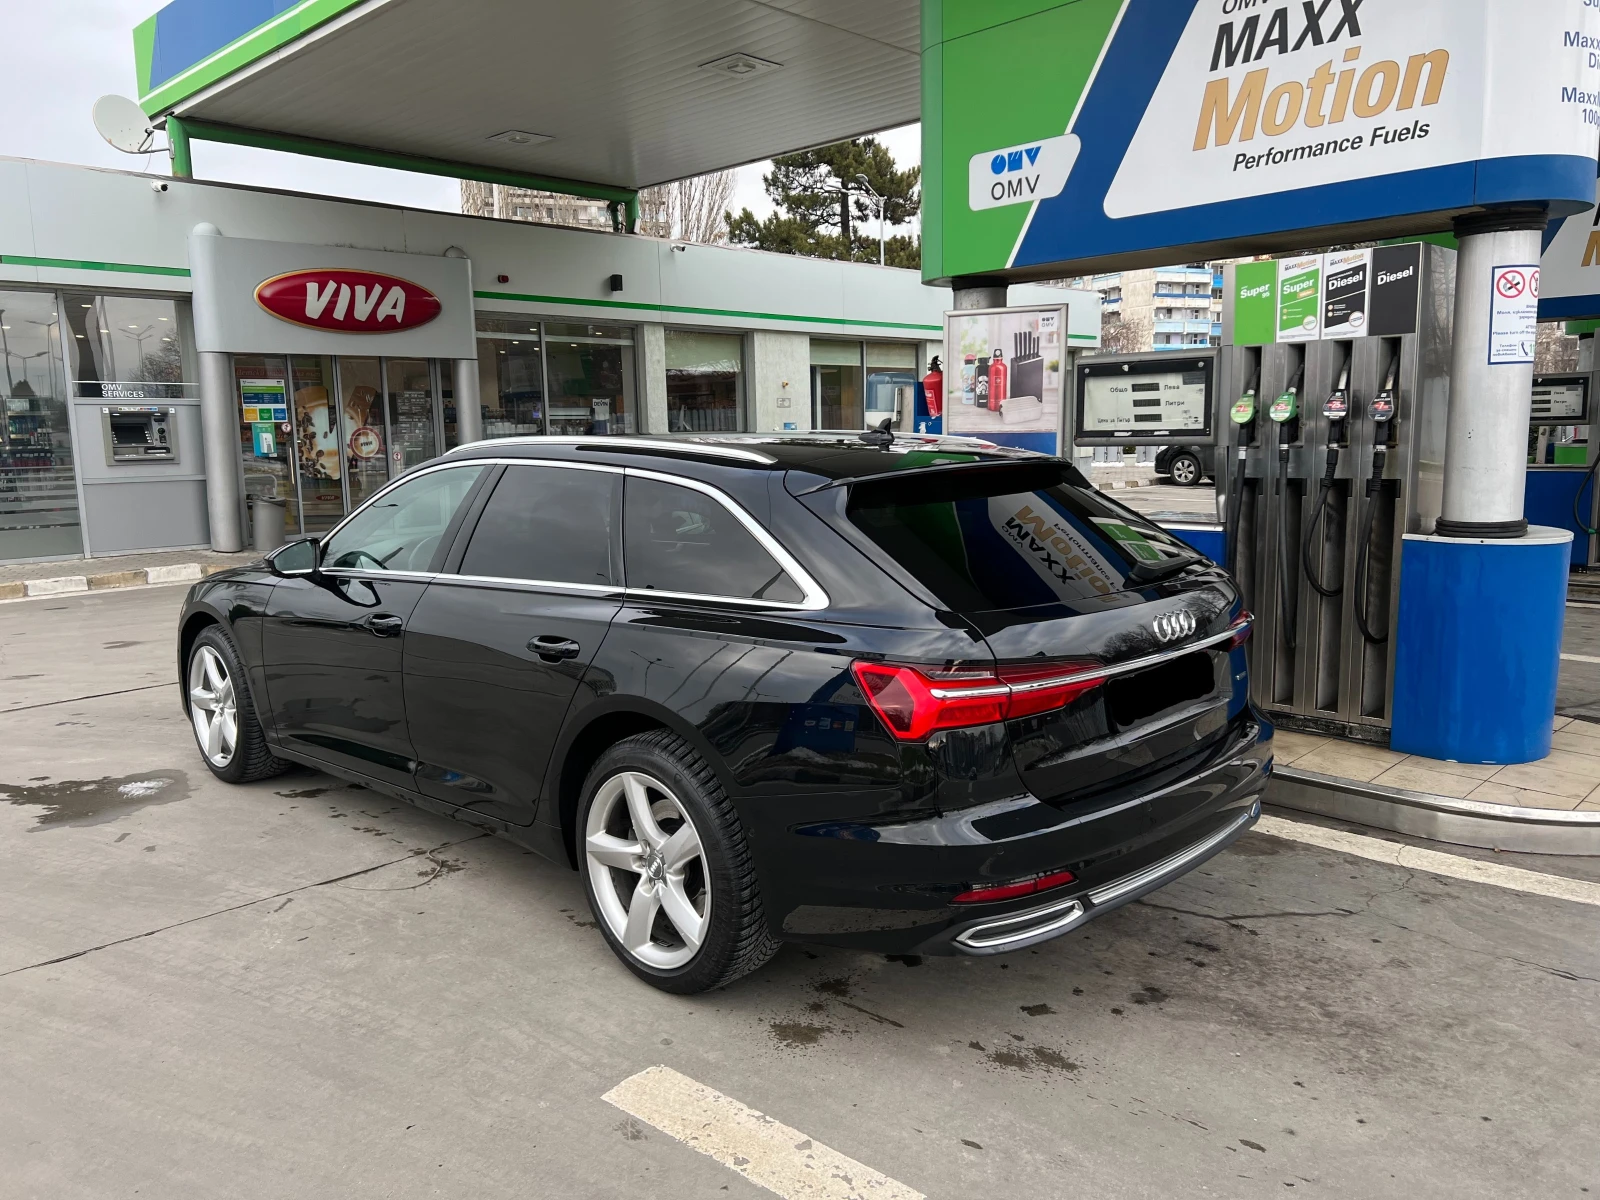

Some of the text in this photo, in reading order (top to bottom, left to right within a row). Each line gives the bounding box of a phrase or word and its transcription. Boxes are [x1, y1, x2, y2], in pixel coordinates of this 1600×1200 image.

[1209, 0, 1363, 72] MAXX
[1192, 45, 1450, 152] Motion
[1232, 119, 1431, 172] Performance Fuels
[990, 173, 1041, 201] OMV
[1328, 270, 1364, 291] Diesel
[1377, 265, 1414, 286] Diesel
[1240, 283, 1271, 299] Super
[1261, 291, 1271, 299] 95
[1282, 278, 1315, 295] Super
[304, 279, 407, 324] VIVA
[101, 383, 122, 391] OMV
[102, 390, 144, 398] SERVICES
